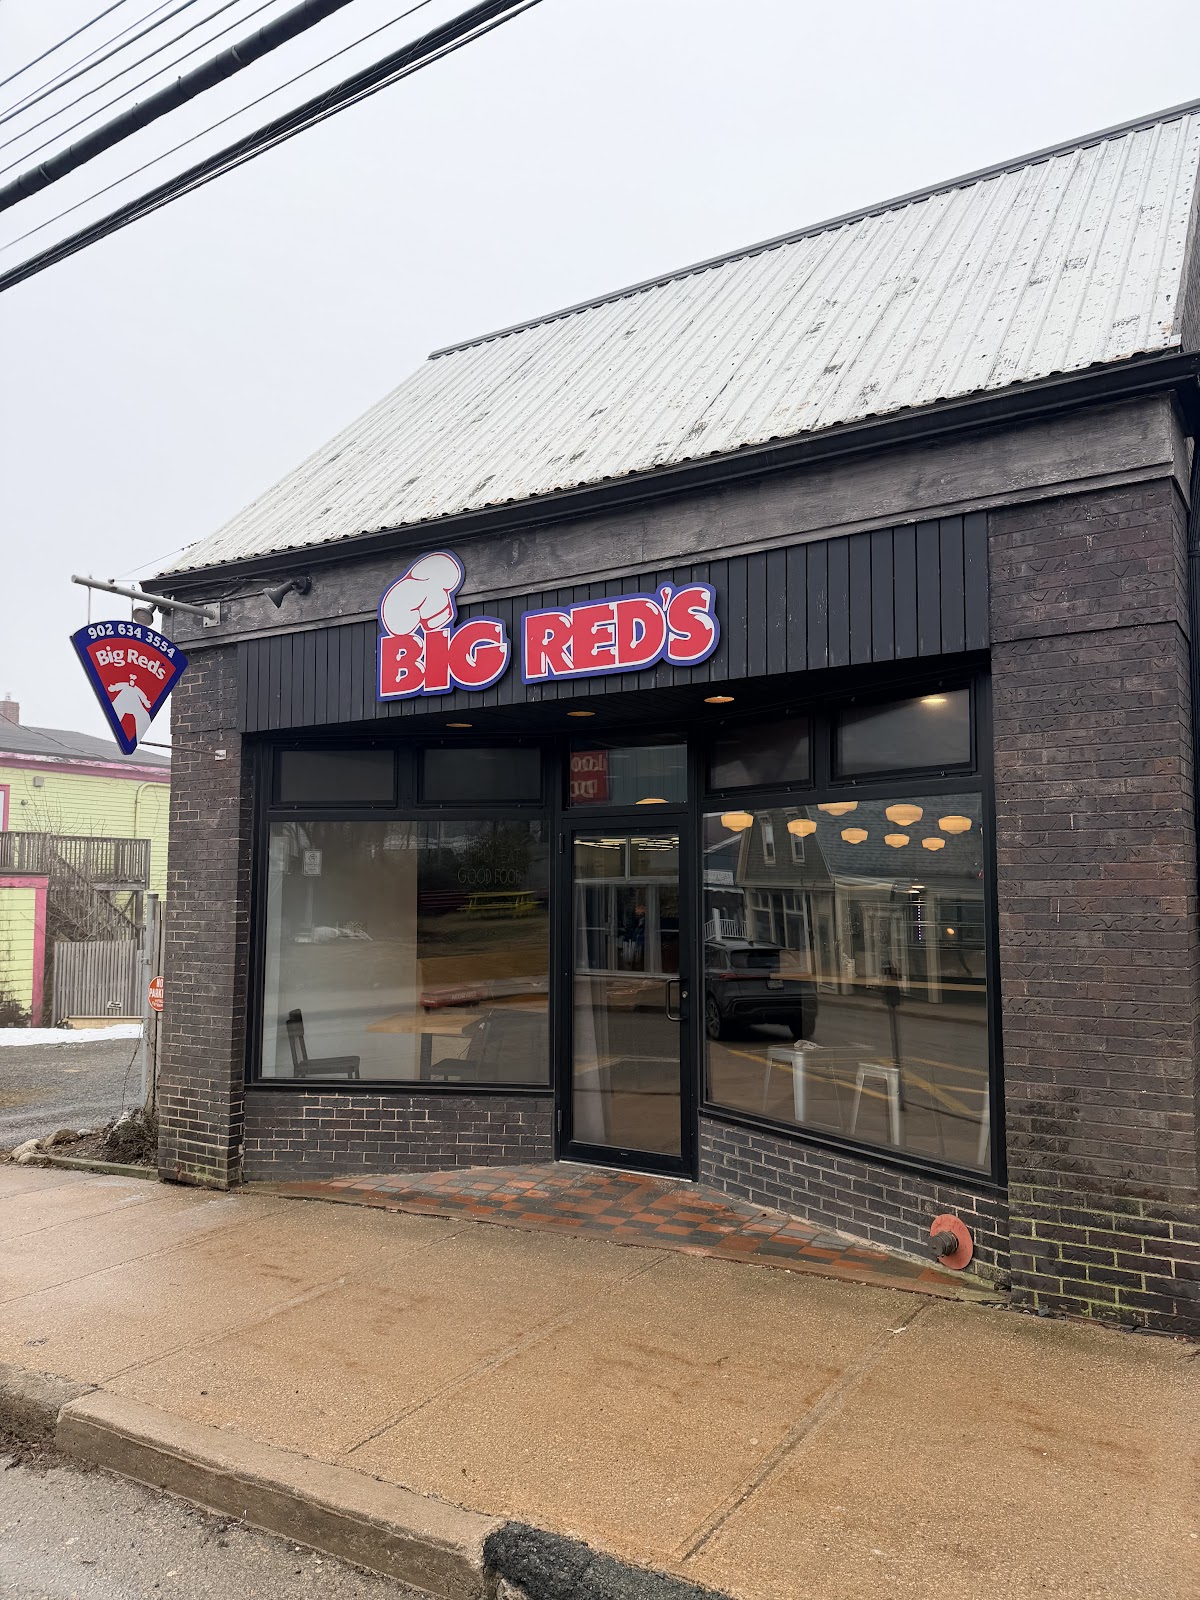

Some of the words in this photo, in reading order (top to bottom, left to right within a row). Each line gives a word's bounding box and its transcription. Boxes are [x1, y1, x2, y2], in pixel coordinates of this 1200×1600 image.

[88, 624, 114, 639] 902
[117, 623, 143, 639] 634
[145, 631, 176, 659] 3554
[380, 620, 508, 698] BIG
[525, 586, 715, 680] RED'S
[95, 646, 126, 667] Big
[457, 867, 492, 884] GOOD
[494, 868, 522, 884] FOOD
[148, 987, 164, 999] PARKI
